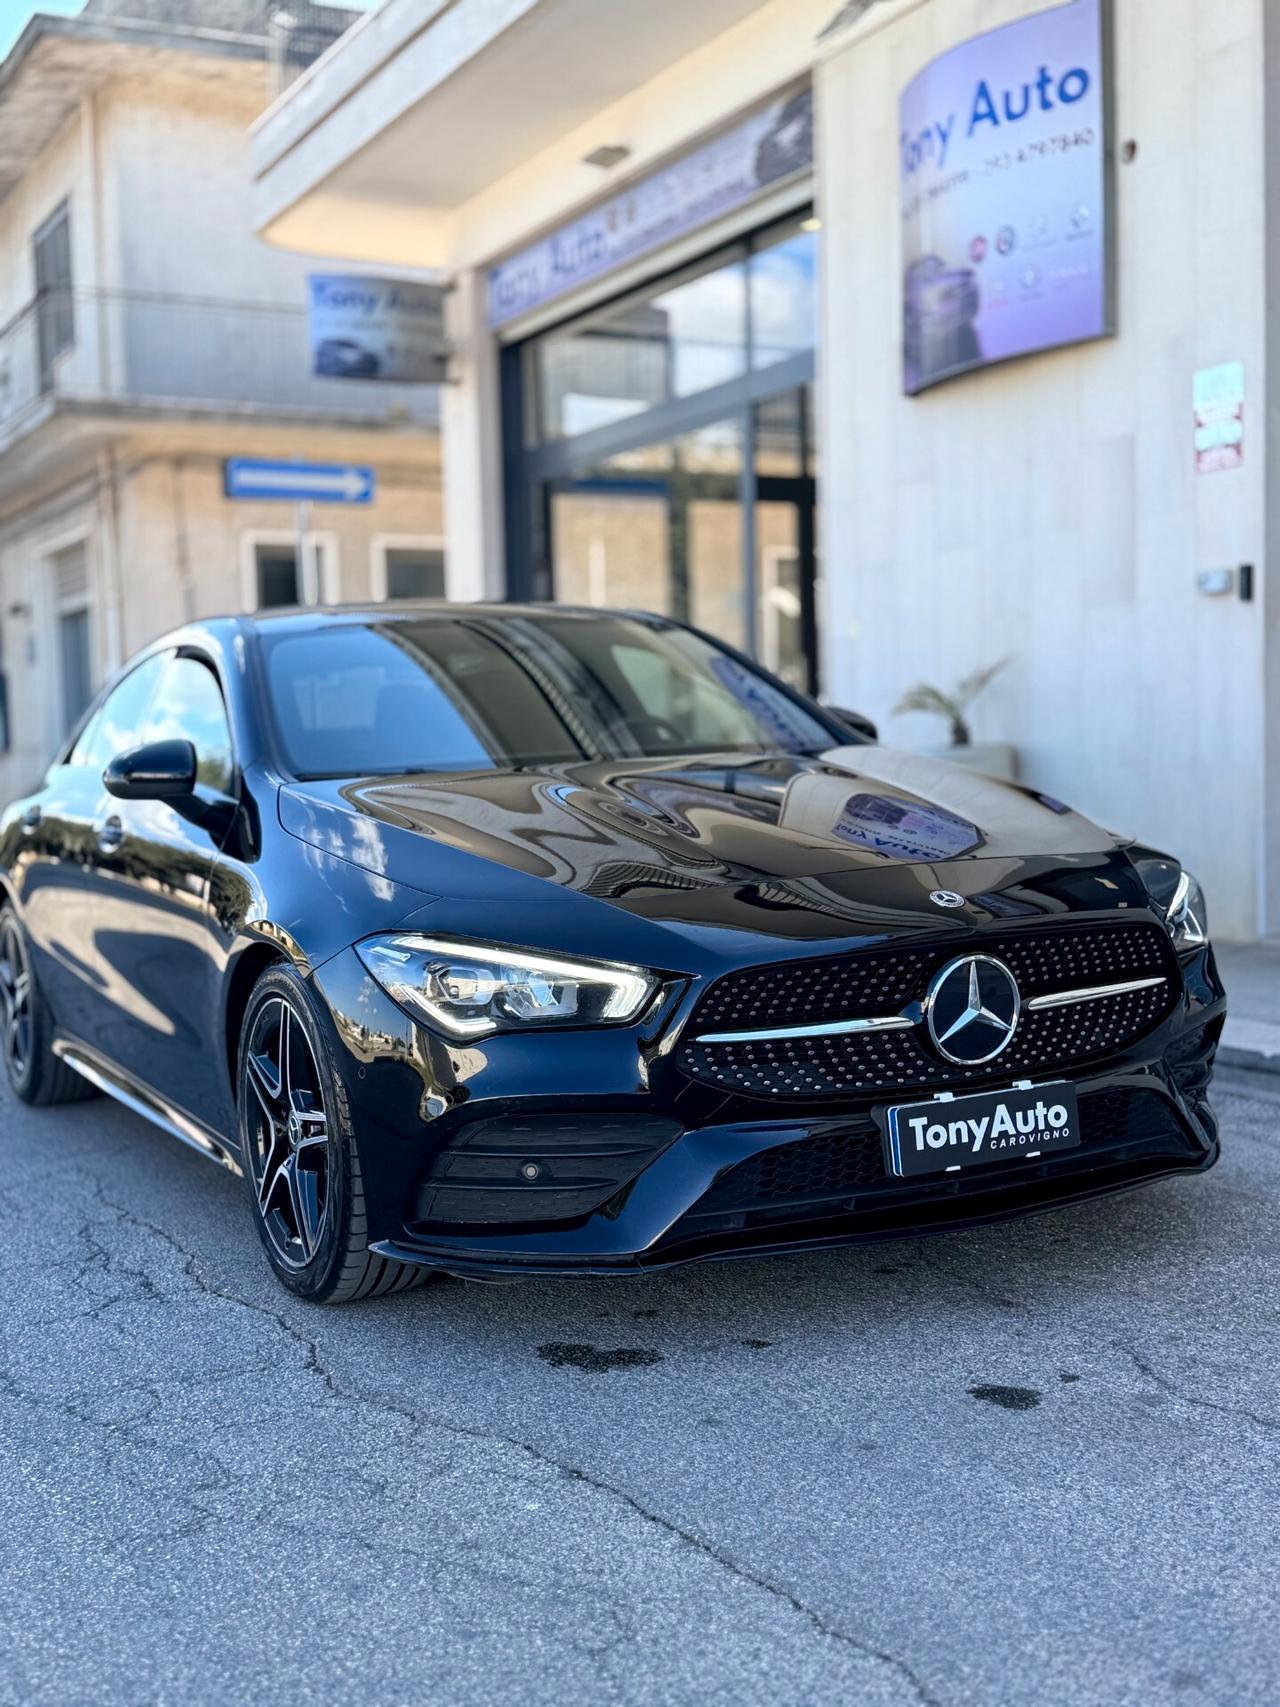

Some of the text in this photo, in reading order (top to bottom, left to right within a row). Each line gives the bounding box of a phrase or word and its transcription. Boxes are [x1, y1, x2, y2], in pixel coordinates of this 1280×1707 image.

[966, 65, 1090, 138] Auto
[908, 1101, 1068, 1152] TonyAuto
[990, 1127, 1070, 1149] CAROVIGNO
